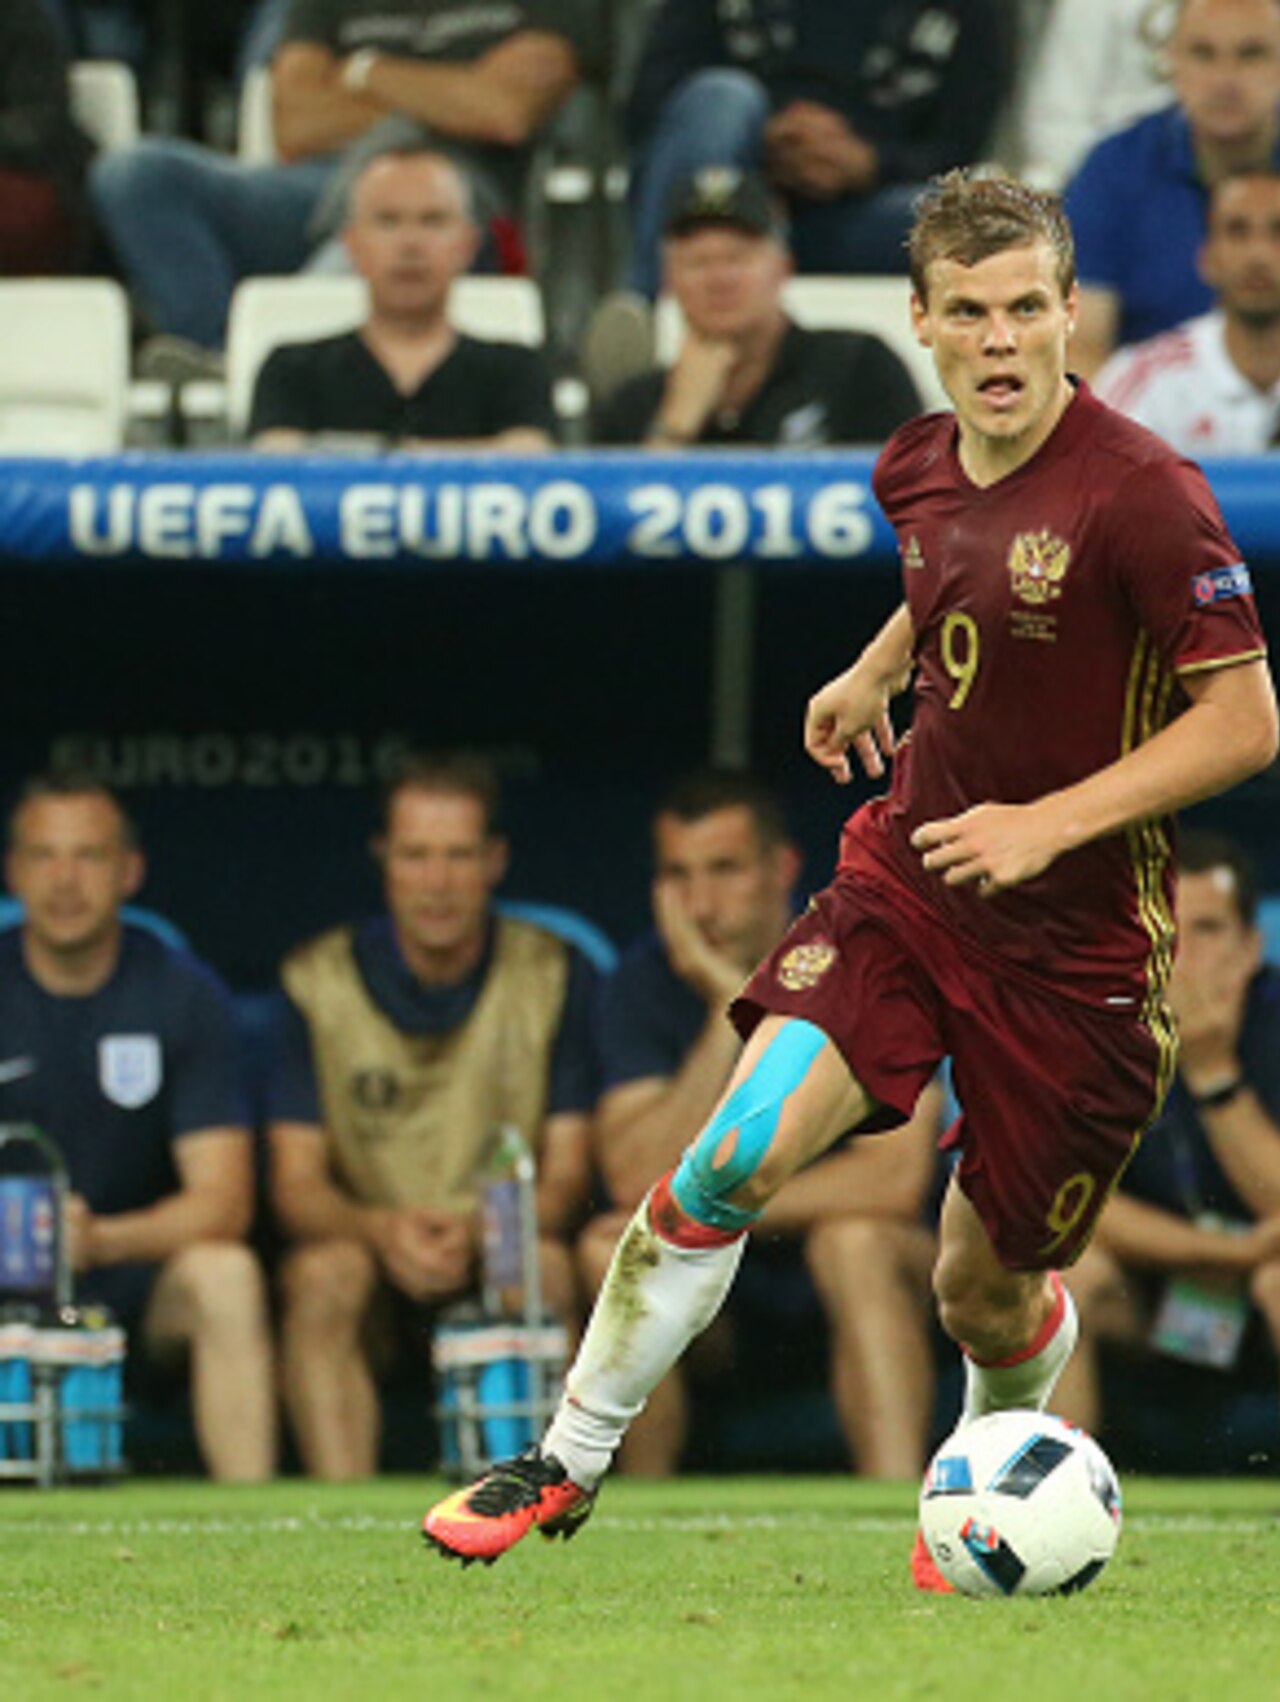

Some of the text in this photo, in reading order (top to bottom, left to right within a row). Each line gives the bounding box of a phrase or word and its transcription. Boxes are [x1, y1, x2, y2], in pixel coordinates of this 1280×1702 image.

[69, 481, 873, 559] UEFA EURO 2016
[942, 611, 979, 710] 9
[1039, 1173, 1095, 1254] 9
